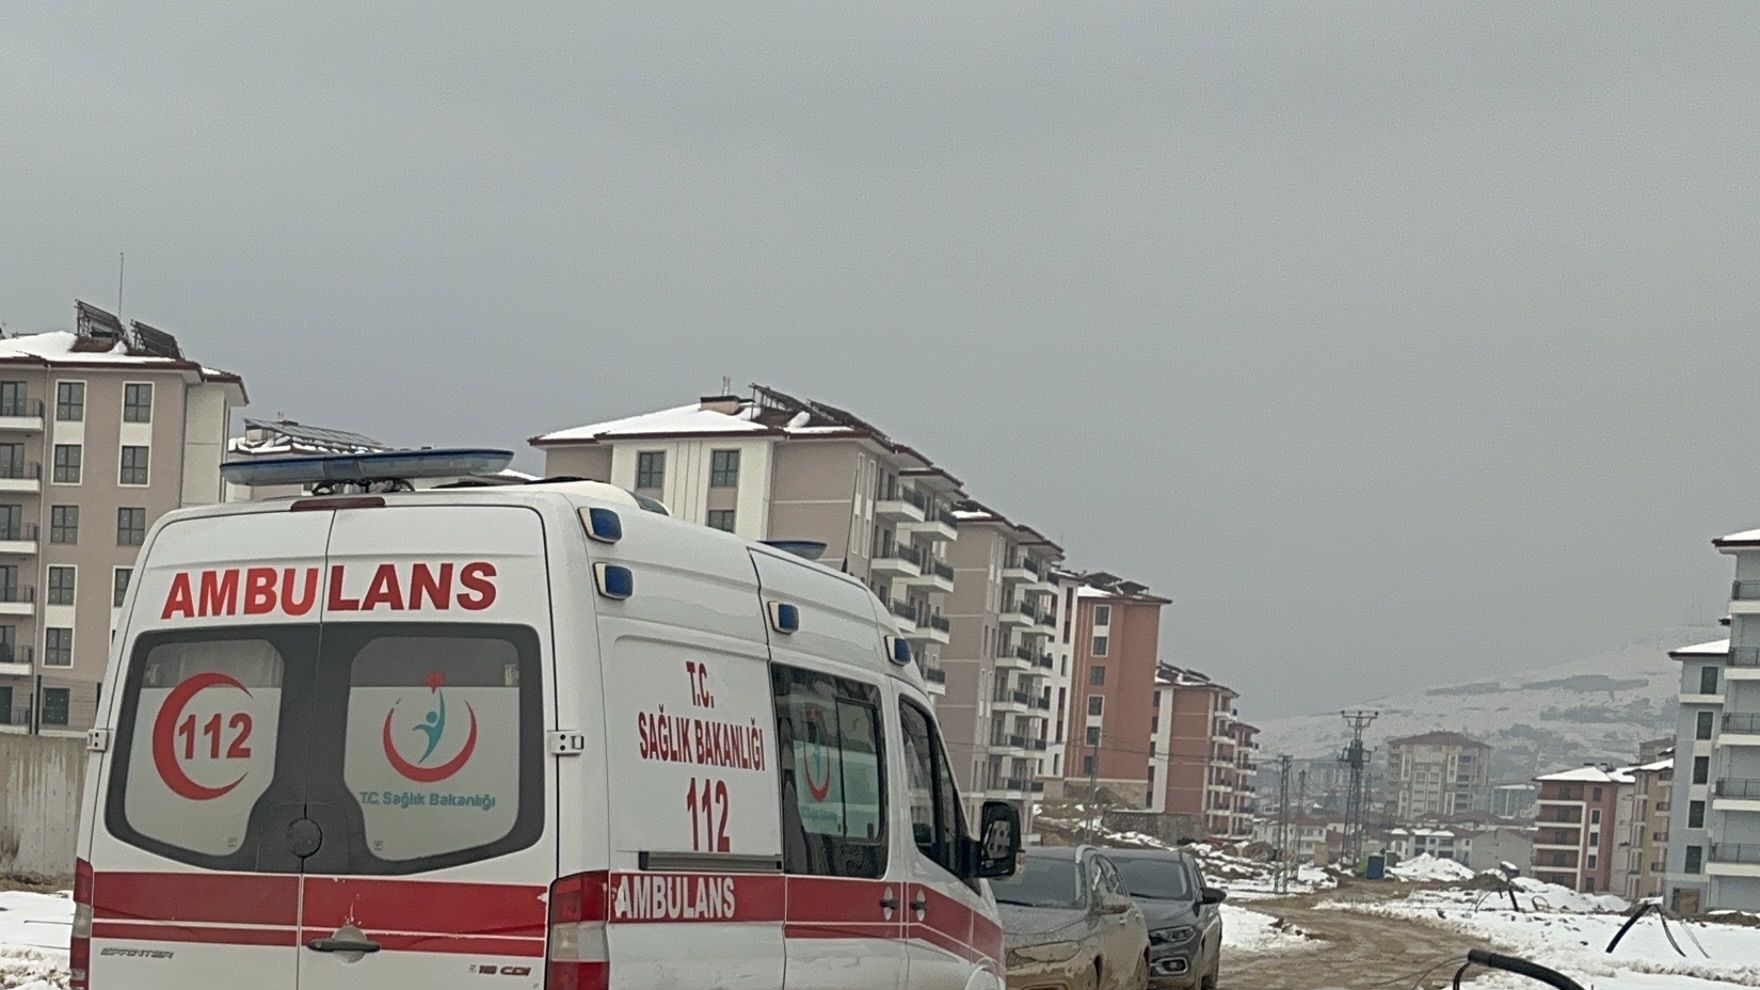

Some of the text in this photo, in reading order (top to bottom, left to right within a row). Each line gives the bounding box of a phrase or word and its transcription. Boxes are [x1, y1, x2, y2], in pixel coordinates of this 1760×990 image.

[160, 561, 498, 620] AMBULANS
[685, 660, 715, 708] T.C.
[178, 712, 254, 760] 112
[638, 703, 766, 772] SAĞLIK BAKANLIĞI
[382, 791, 426, 809] Sağlık
[429, 792, 496, 812] Bakanlığı
[686, 776, 731, 853] 112
[614, 874, 736, 920] AMBULANS
